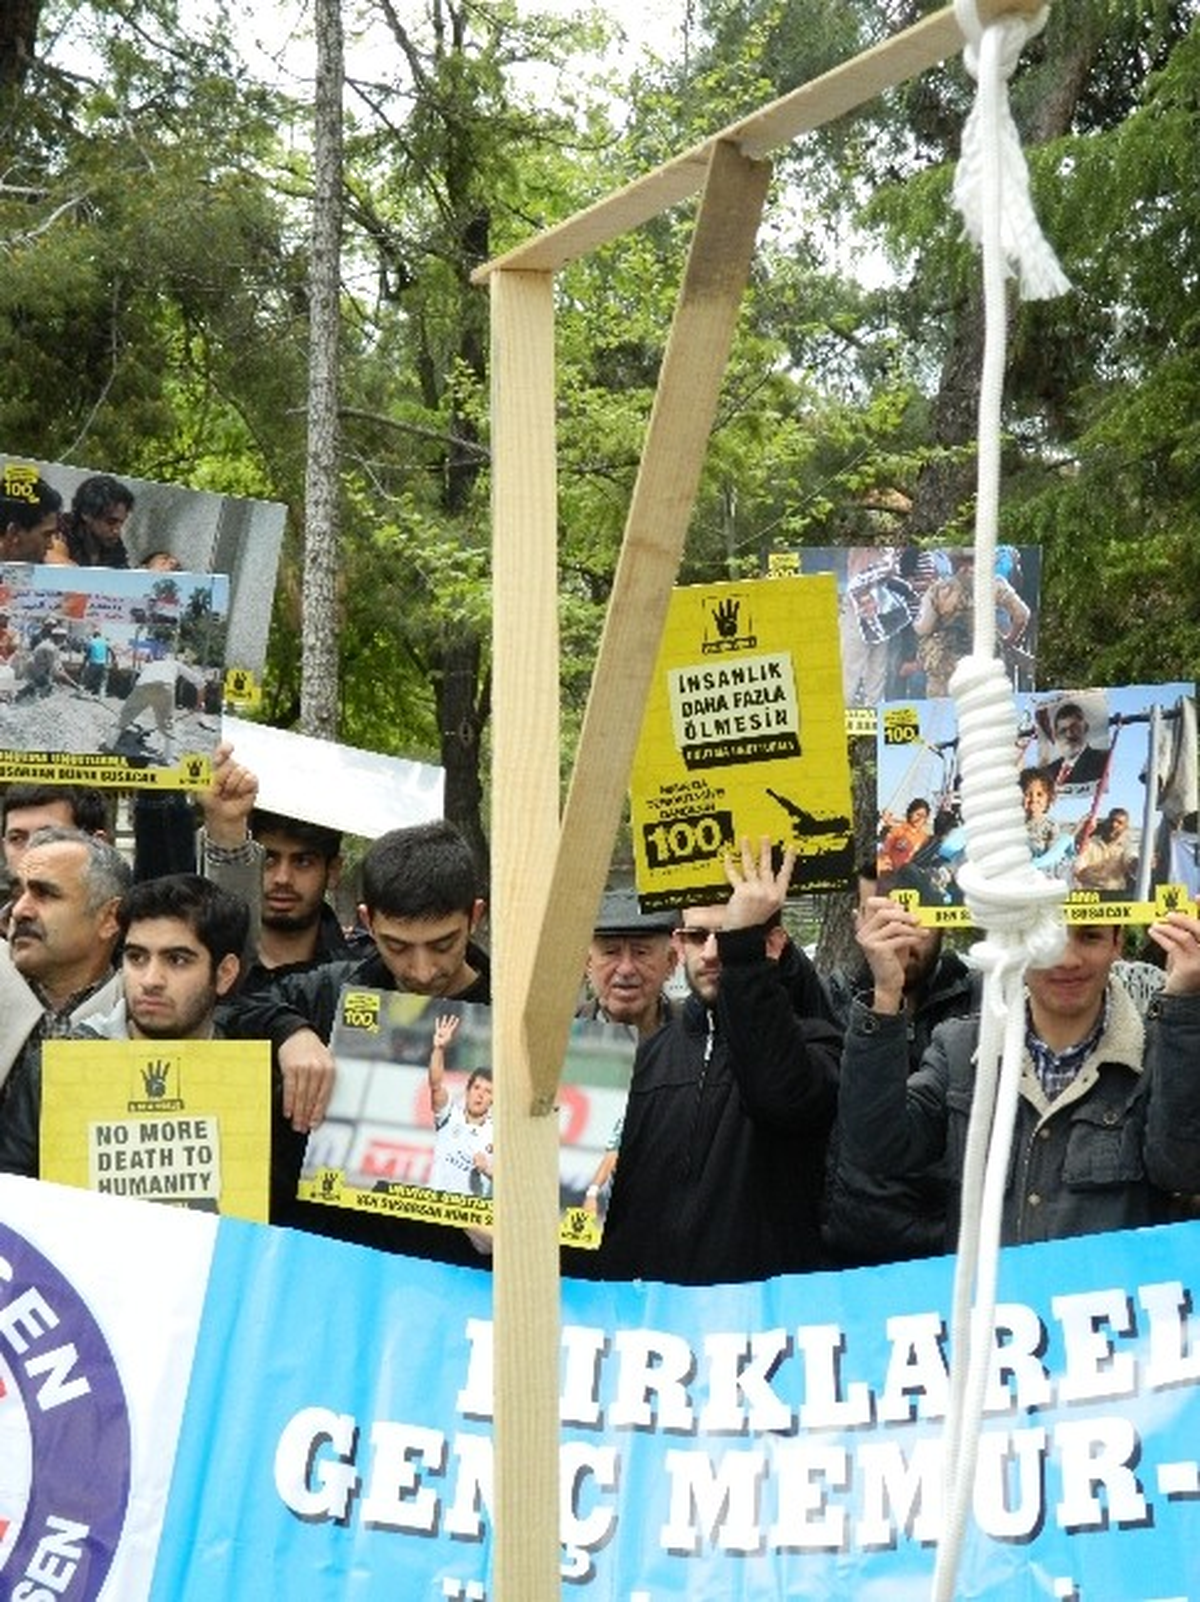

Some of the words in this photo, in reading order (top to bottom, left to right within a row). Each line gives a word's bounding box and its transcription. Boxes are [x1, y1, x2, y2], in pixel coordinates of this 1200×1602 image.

[682, 694, 729, 718] DAHA
[733, 685, 786, 708] FAZLA
[684, 706, 788, 740] ÖLMESİN
[96, 1125, 128, 1146] NO
[140, 1121, 207, 1143] MORE
[98, 1148, 173, 1171] DEATH
[183, 1145, 212, 1166] TO
[98, 1171, 211, 1196] HUMANITY
